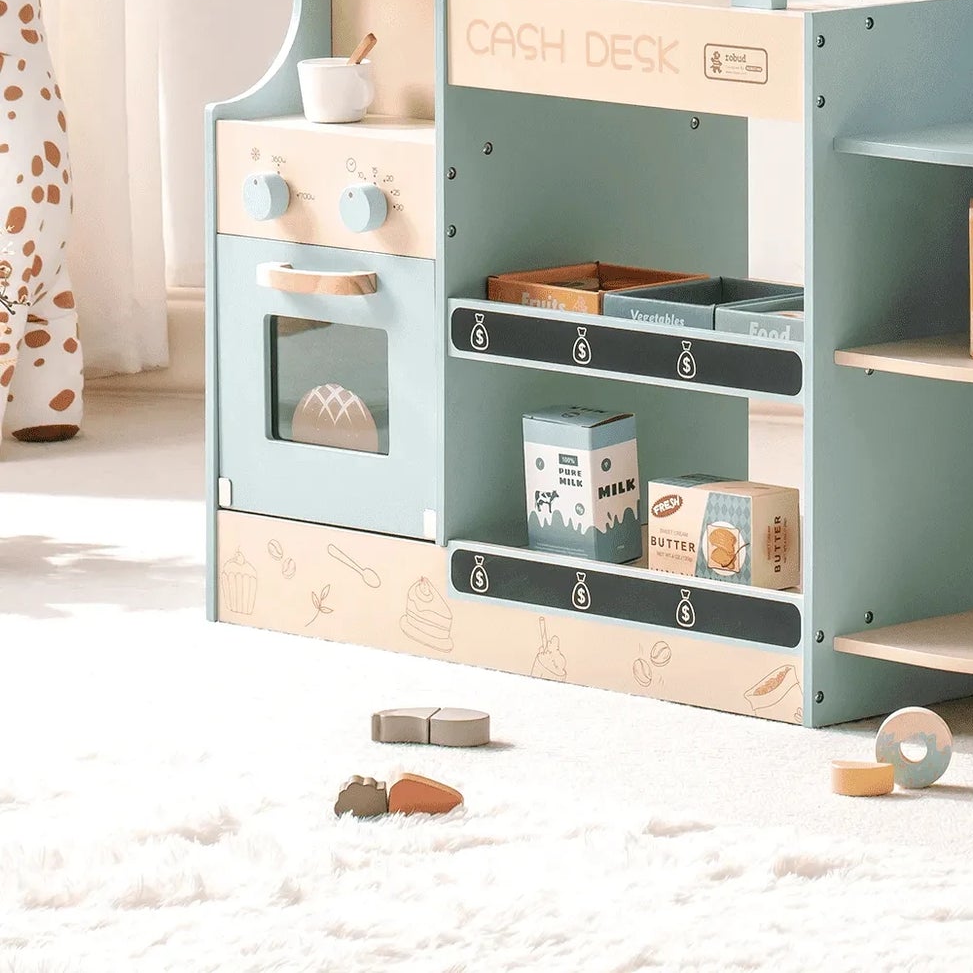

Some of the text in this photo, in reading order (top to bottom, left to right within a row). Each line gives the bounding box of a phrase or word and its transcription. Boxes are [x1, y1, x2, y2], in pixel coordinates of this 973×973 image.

[466, 19, 680, 74] CASH DESK
[521, 292, 566, 312] Fruits
[630, 309, 685, 326] Vegetables
[559, 468, 582, 477] PURE
[559, 477, 583, 487] MILK
[598, 478, 636, 499] MILK
[653, 495, 680, 515] FRESH
[650, 536, 696, 553] BUTTER
